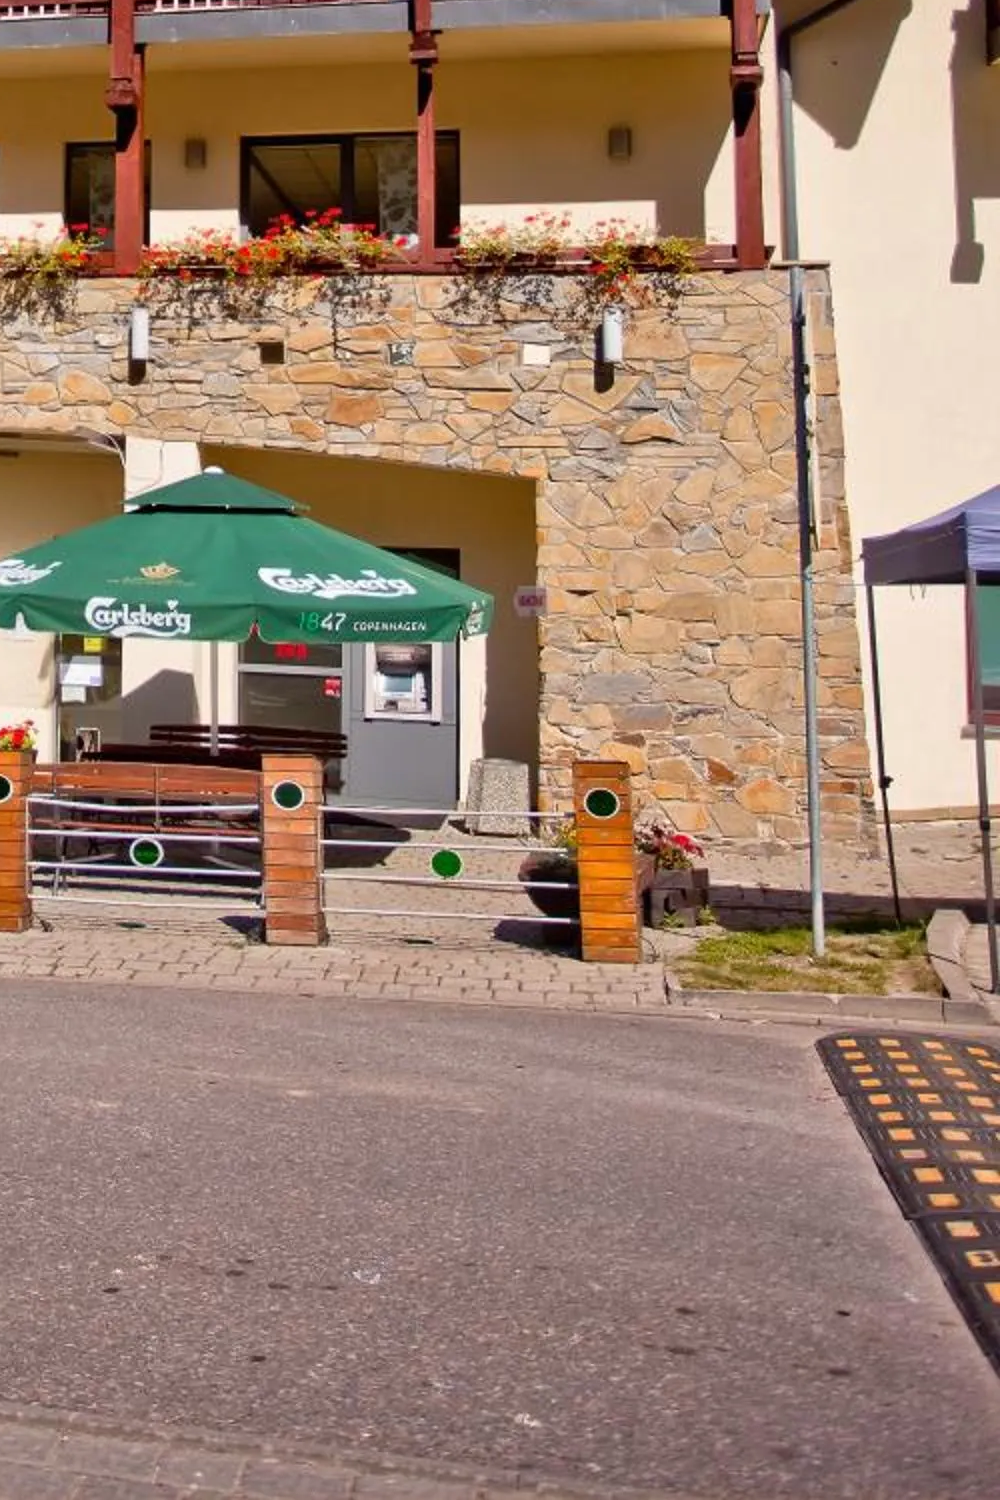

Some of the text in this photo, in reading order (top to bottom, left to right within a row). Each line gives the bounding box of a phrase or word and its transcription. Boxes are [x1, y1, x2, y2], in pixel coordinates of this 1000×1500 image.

[257, 567, 417, 599] Carlsberg
[84, 596, 192, 637] Carlsberg
[300, 611, 428, 632] 1847 COPENHAGEN
